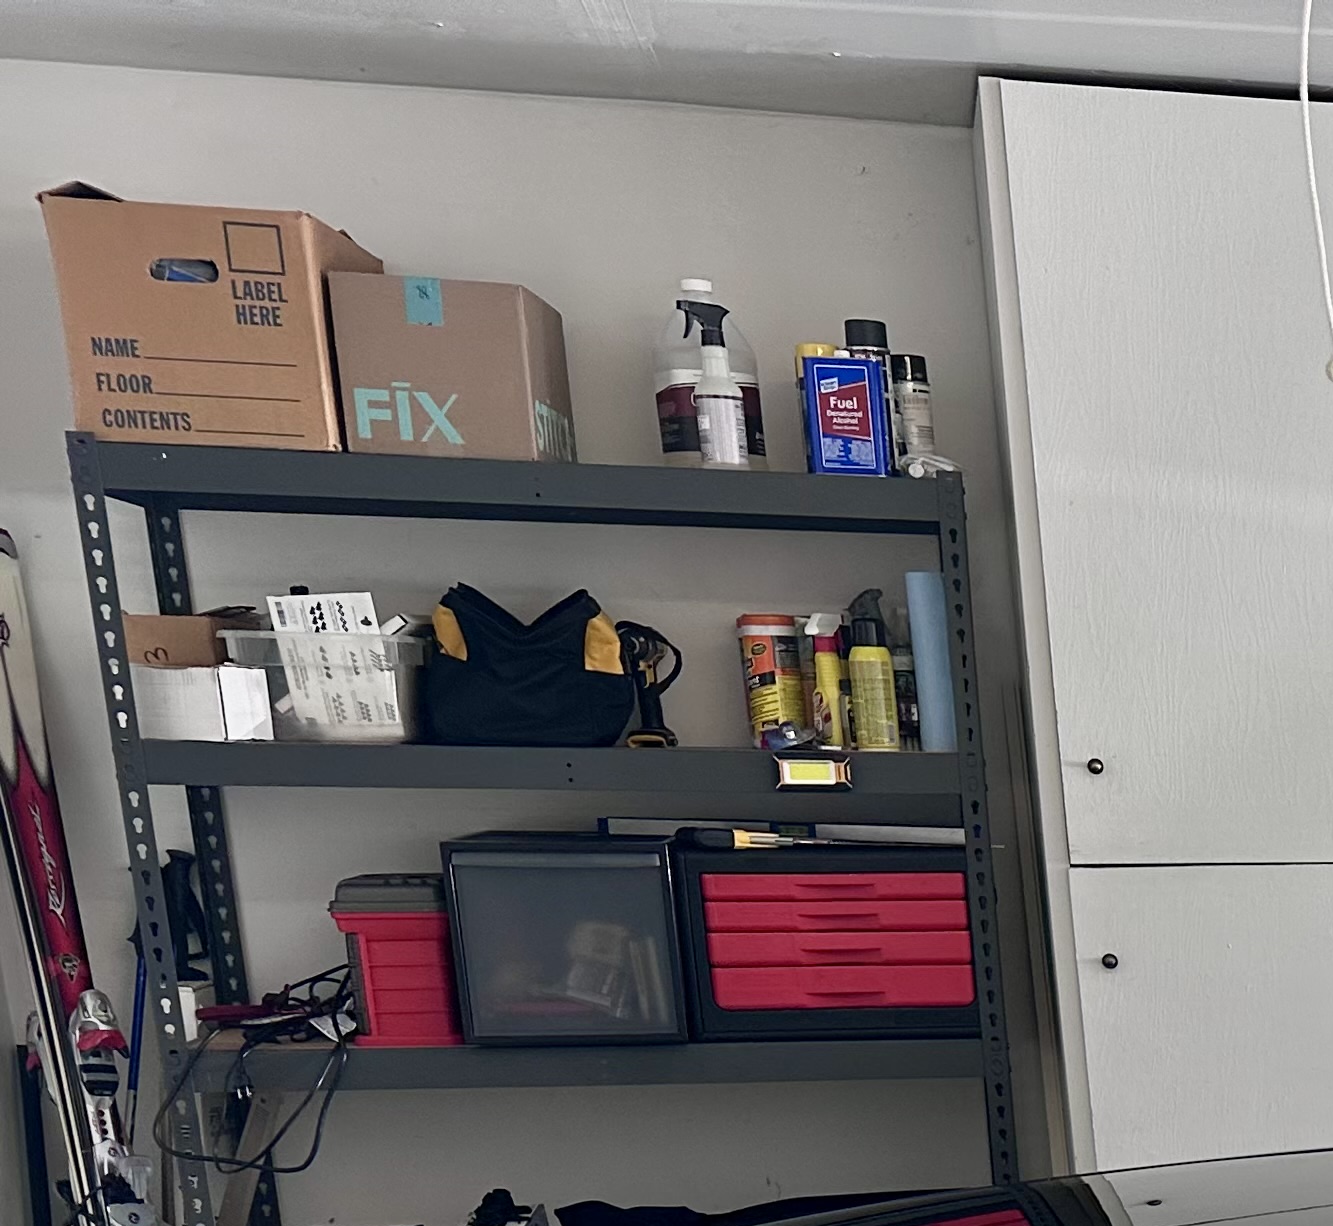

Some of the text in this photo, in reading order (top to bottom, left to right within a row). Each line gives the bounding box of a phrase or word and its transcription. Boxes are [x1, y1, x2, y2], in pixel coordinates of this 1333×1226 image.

[231, 279, 289, 304] LABEL
[235, 304, 283, 327] HERE
[90, 336, 141, 359] NAME
[95, 372, 154, 395] FLOOR
[829, 396, 858, 410] Fuel
[101, 408, 192, 432] CONTENTS
